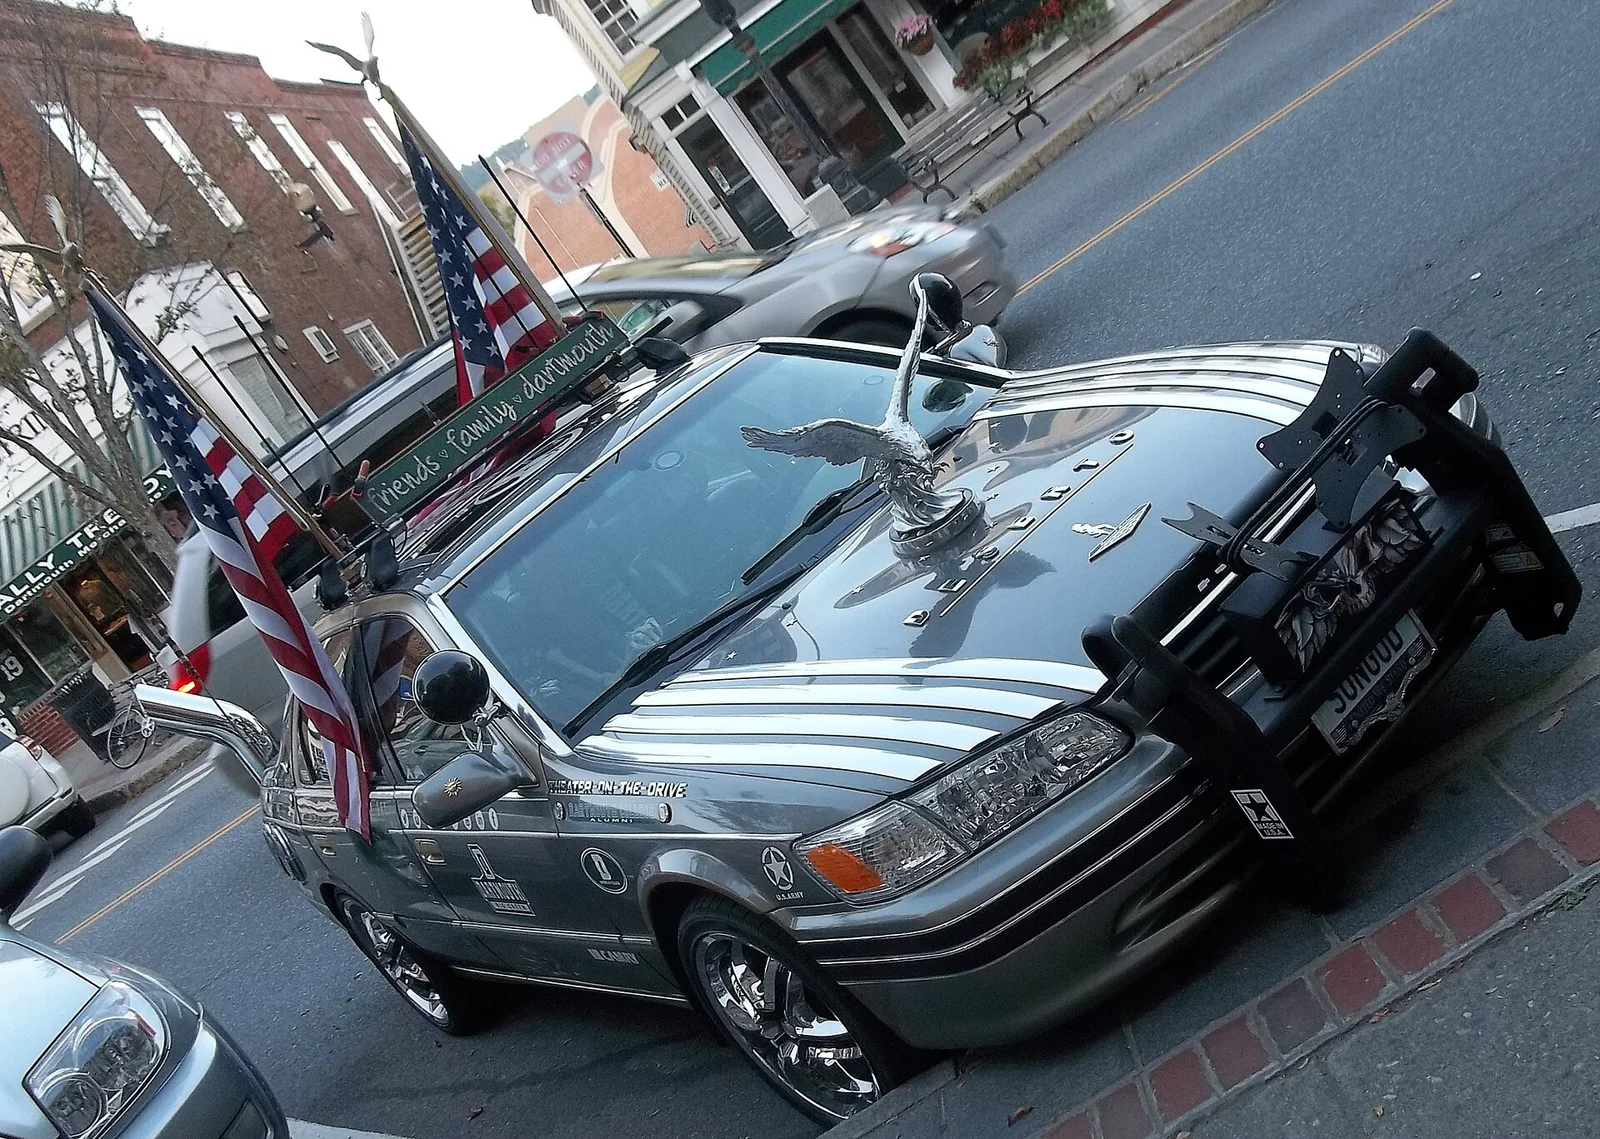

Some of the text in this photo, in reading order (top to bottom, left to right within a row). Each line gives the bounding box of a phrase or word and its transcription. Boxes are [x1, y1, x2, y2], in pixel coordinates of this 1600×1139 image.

[367, 323, 615, 514] friends family dartmouth
[3, 560, 74, 614] Dartmouth
